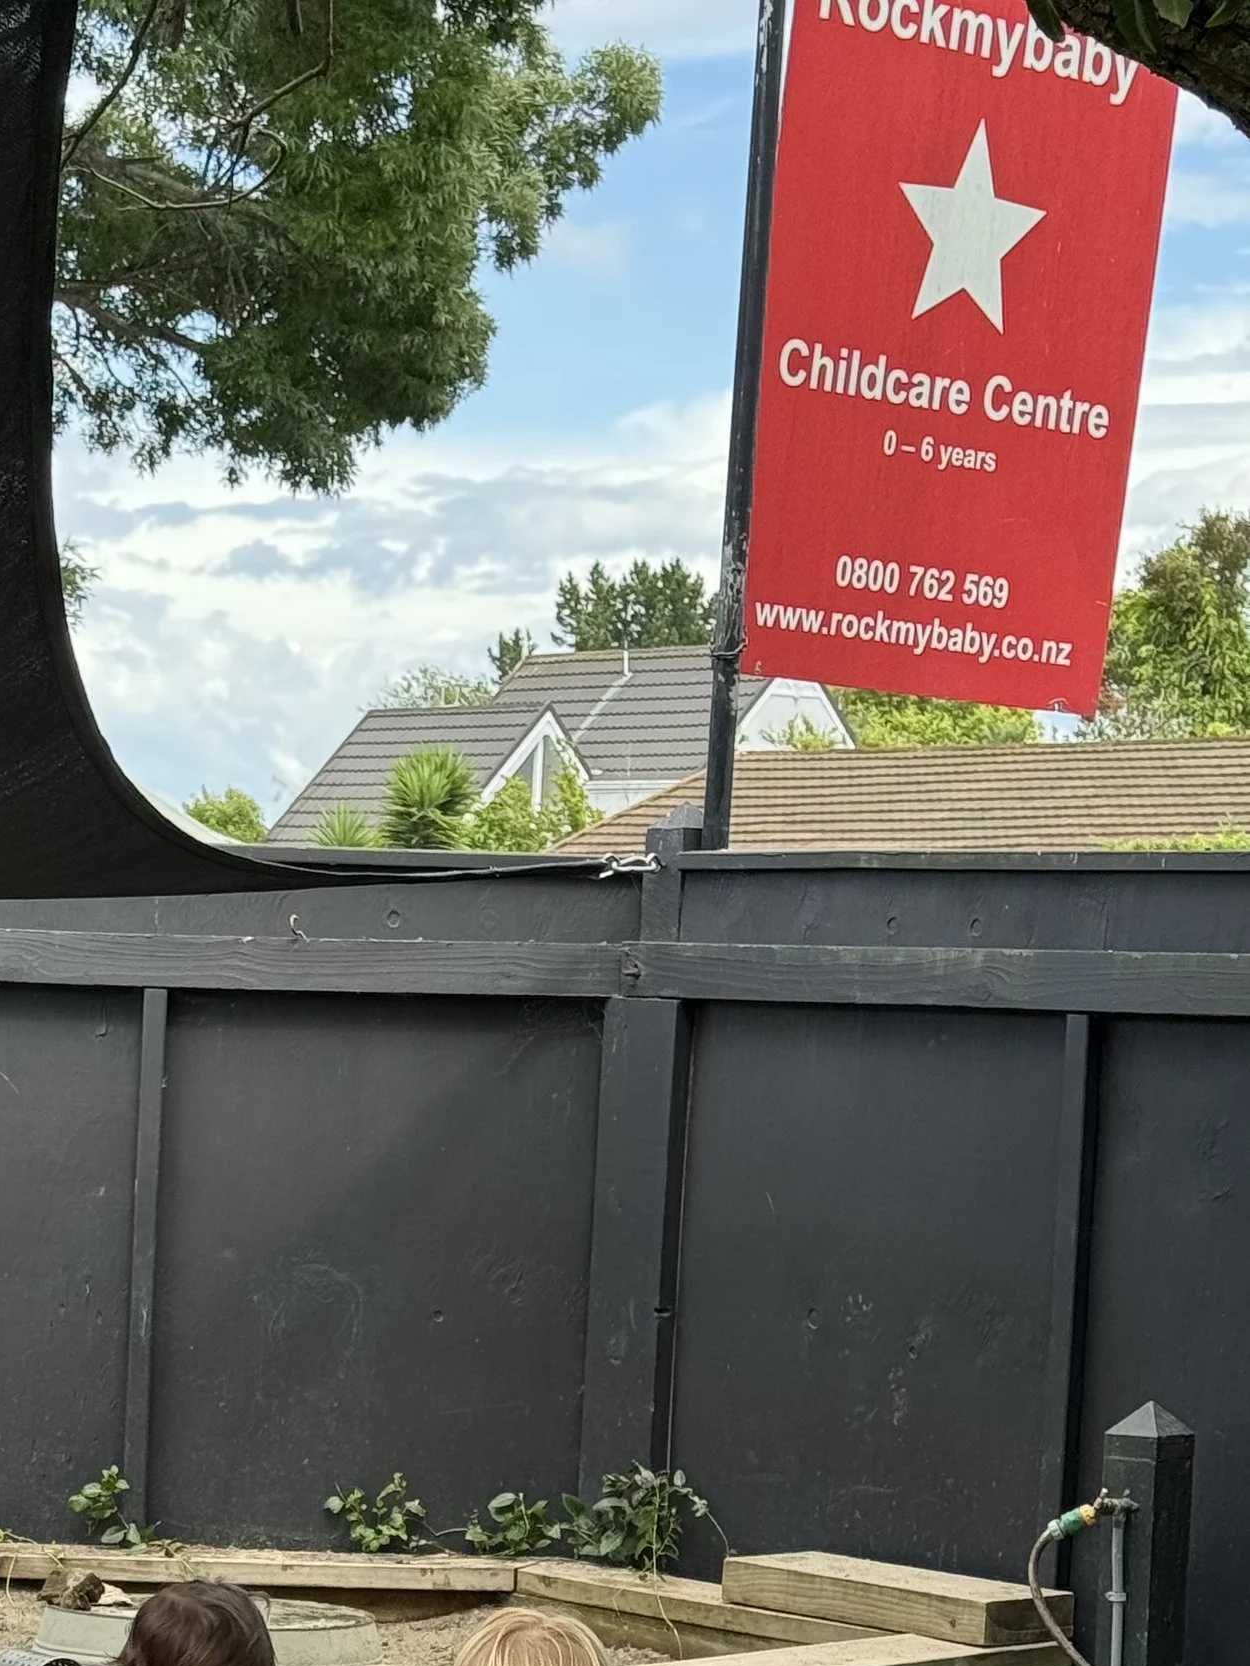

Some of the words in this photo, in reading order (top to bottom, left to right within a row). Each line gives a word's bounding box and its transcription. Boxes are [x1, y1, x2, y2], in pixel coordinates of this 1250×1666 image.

[779, 338, 971, 415] Childcare
[983, 375, 1110, 439] Centre
[883, 430, 897, 456] 0
[920, 436, 934, 462] 6
[937, 444, 997, 473] years
[836, 555, 900, 595] 0800
[909, 565, 955, 602] 762
[961, 573, 1010, 609] 569
[755, 602, 1073, 667] www.rockmybaby.co.nz
